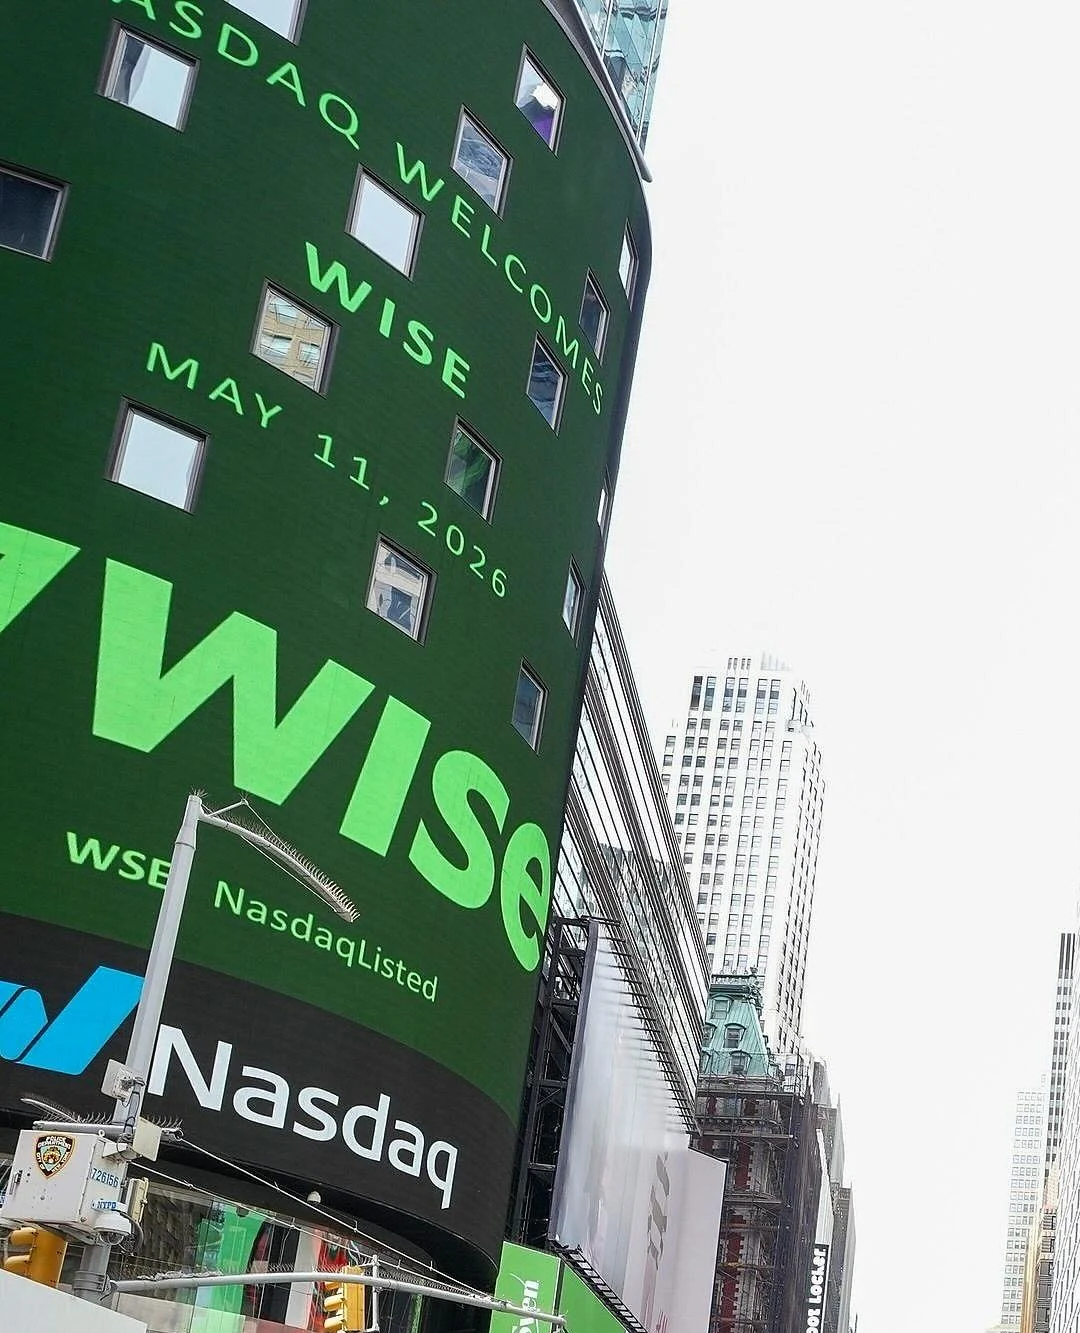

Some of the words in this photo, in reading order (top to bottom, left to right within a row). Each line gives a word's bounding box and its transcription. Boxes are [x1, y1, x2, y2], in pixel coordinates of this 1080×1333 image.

[305, 242, 471, 398] WISE
[396, 142, 604, 415] WELCOMES
[147, 343, 282, 428] MAY
[314, 434, 390, 505] 11,
[417, 501, 509, 597] 2026
[66, 831, 170, 890] WSE
[214, 880, 438, 1003] NasdaqListed
[148, 1023, 457, 1210] Nasdaq
